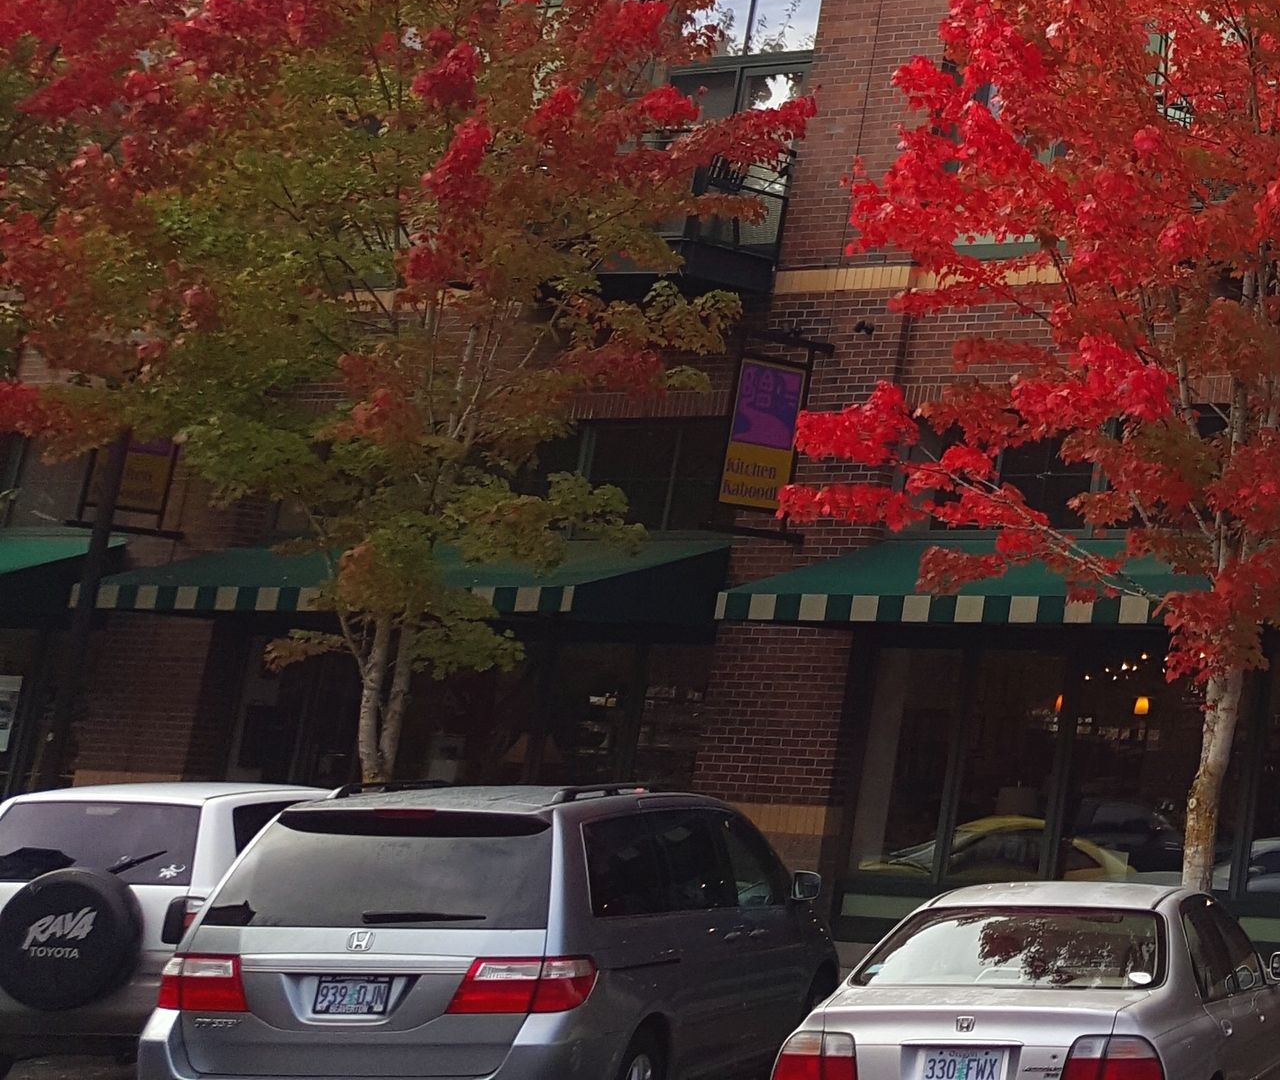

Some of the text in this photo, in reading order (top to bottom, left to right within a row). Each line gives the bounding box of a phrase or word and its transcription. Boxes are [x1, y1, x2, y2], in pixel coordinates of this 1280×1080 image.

[29, 946, 80, 958] TOYOTA
[318, 985, 348, 1005] 939
[925, 1058, 999, 1079] 330 FWX
